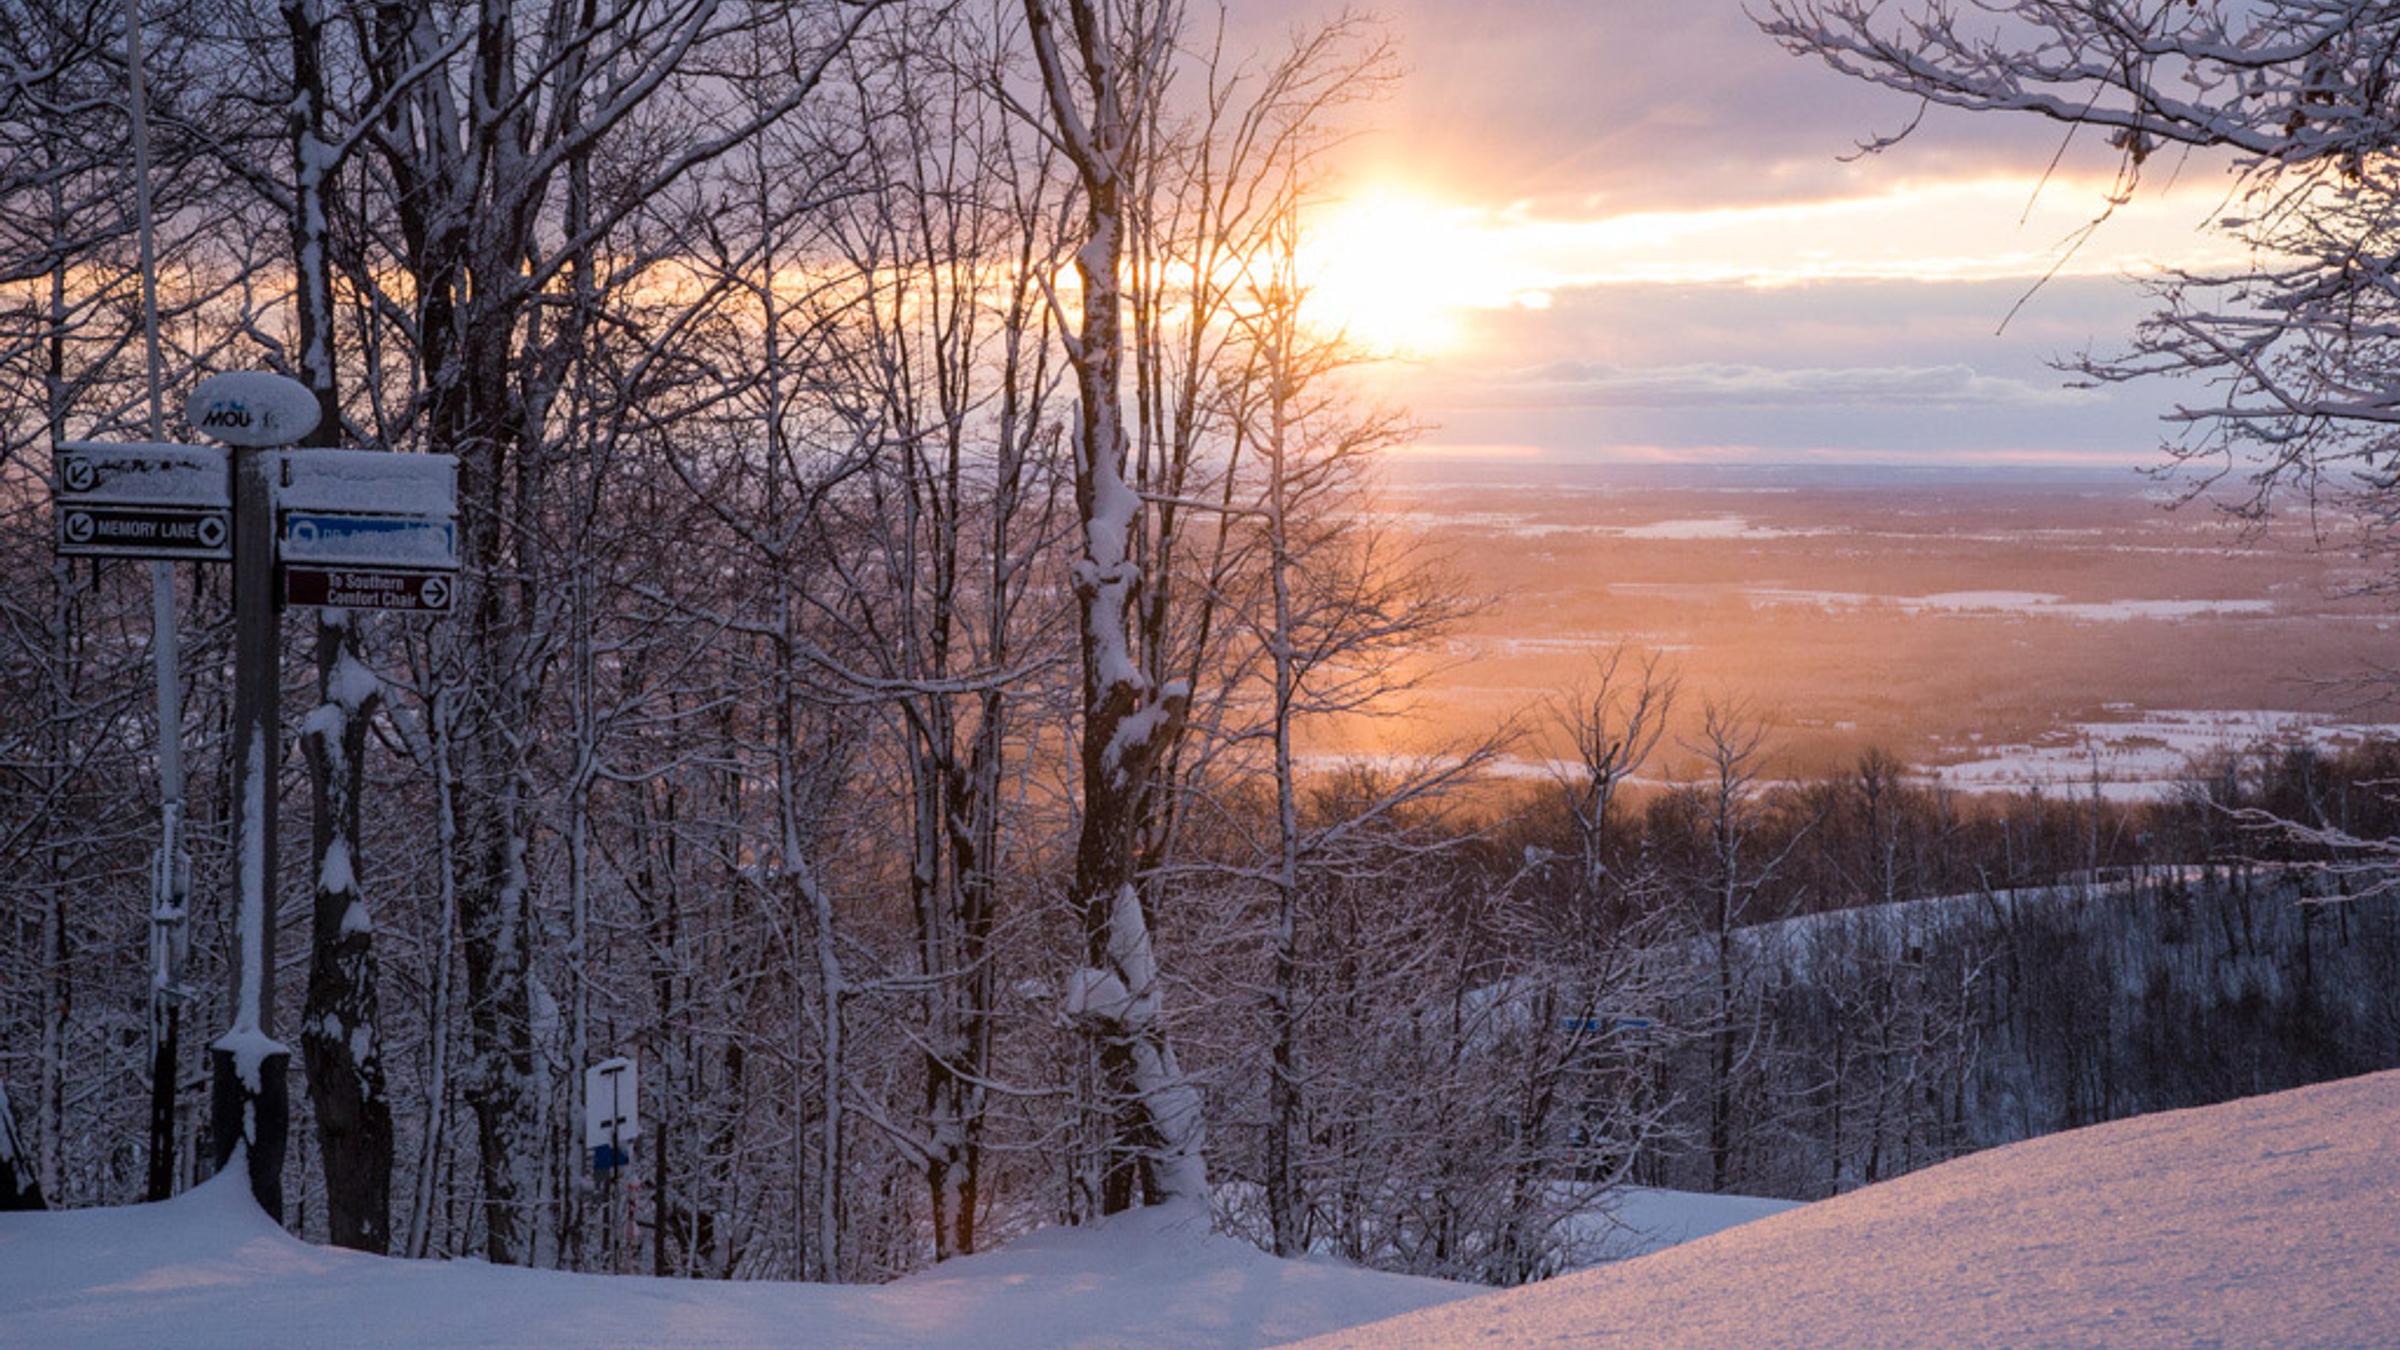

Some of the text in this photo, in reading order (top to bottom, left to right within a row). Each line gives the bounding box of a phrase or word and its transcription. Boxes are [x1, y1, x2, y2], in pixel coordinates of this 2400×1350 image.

[98, 519, 196, 539] MEMORY LANE
[328, 573, 405, 591] To Southern
[327, 590, 417, 608] Comfort Chair
